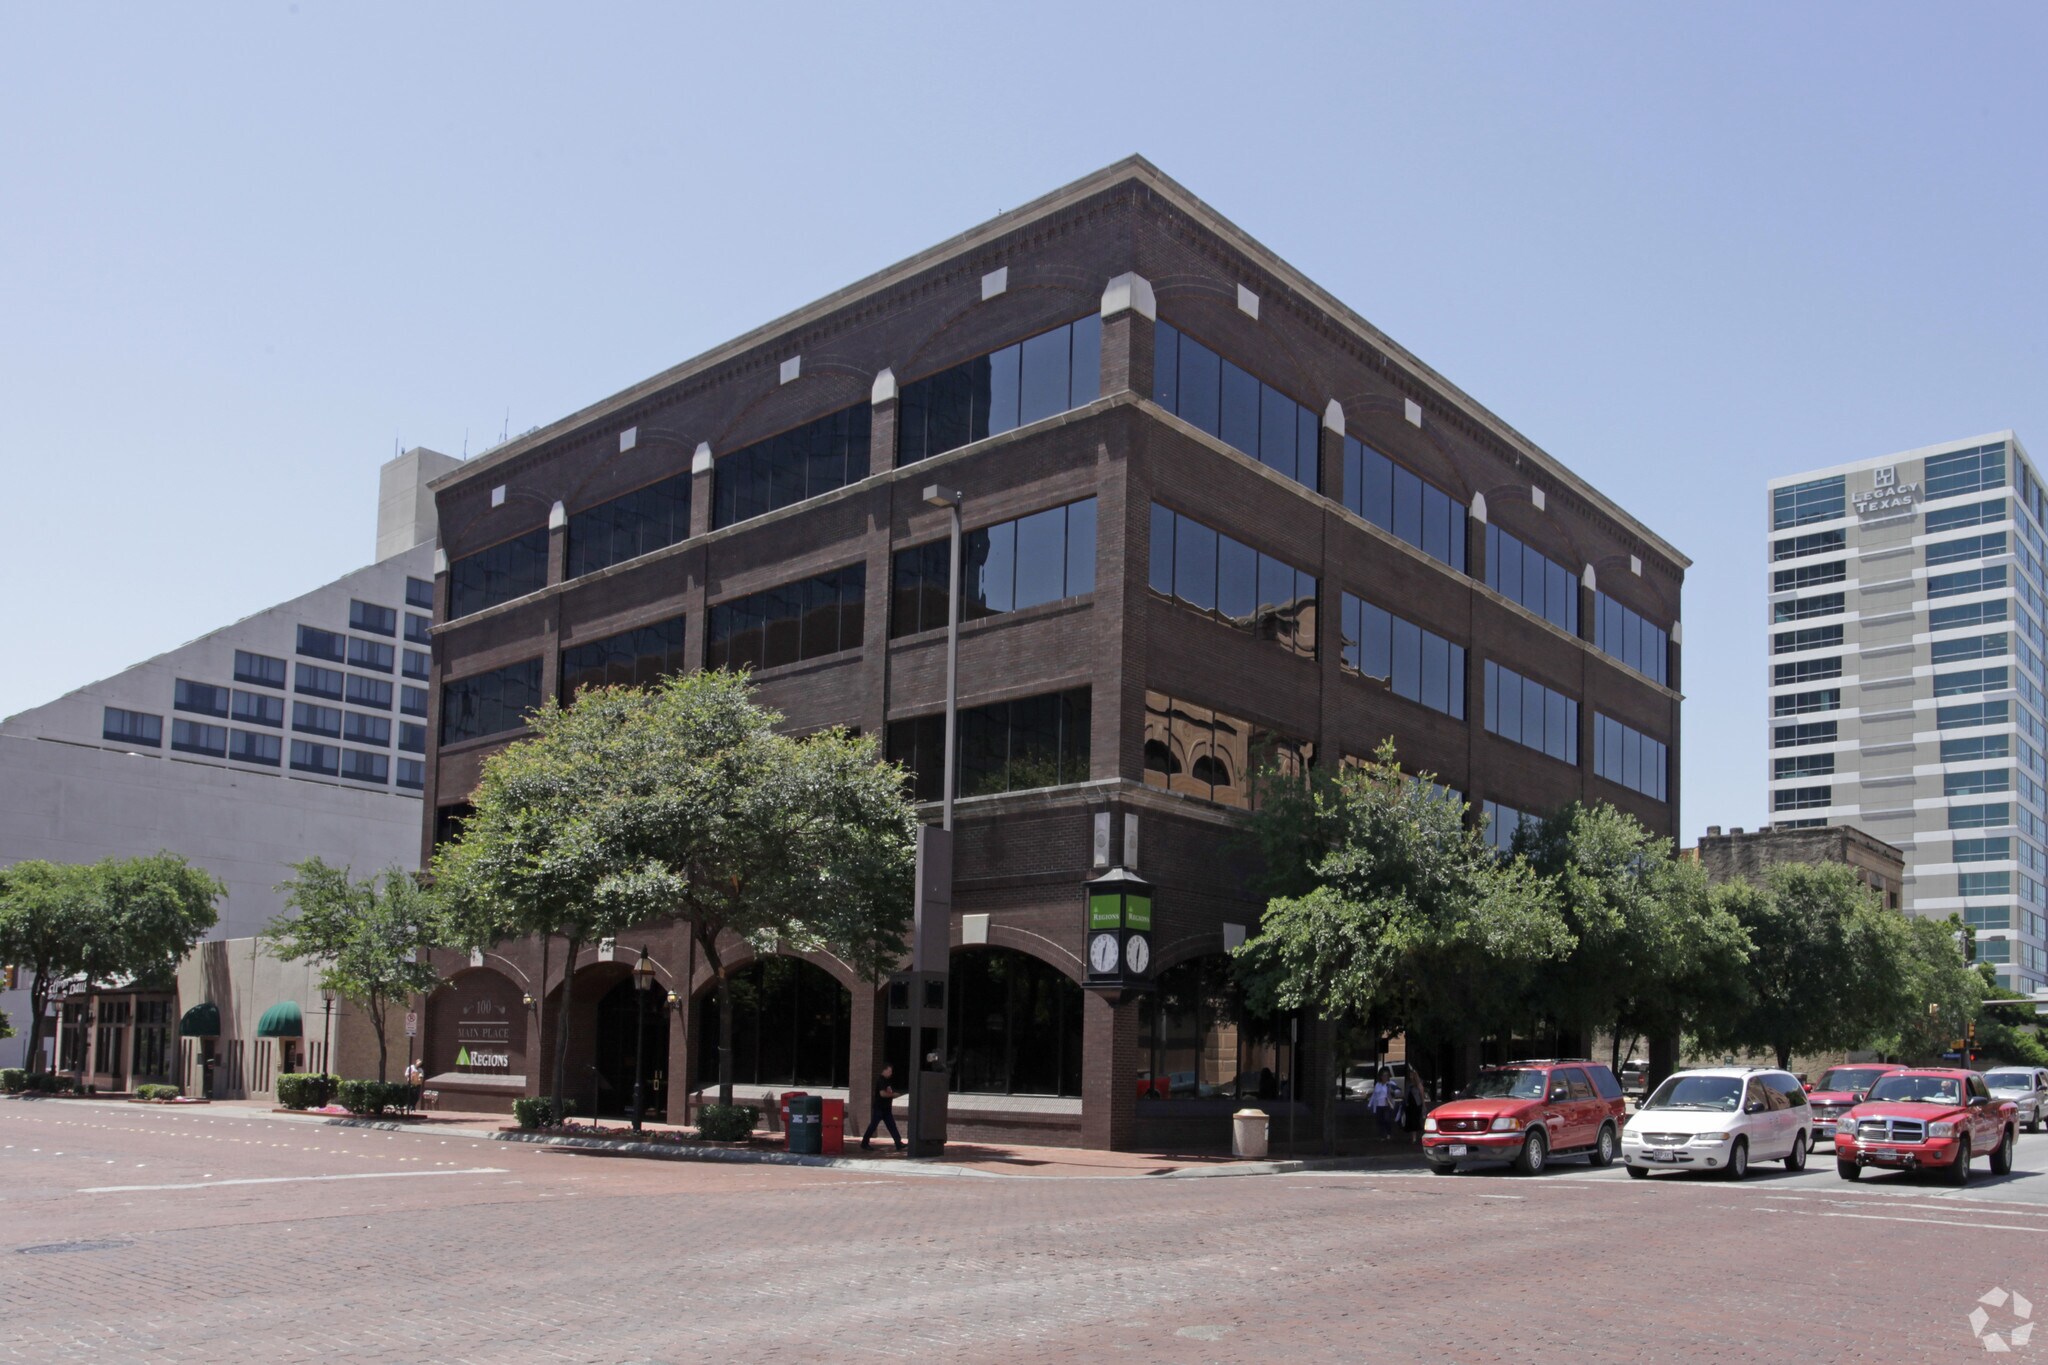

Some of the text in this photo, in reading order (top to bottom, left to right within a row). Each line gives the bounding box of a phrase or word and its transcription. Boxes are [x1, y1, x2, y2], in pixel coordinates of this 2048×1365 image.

[1851, 482, 1918, 503] LEGACY
[1857, 496, 1912, 513] TEXAS
[1093, 913, 1120, 921] REGIONS
[477, 1000, 492, 1014] 100
[458, 1028, 509, 1038] MAIN PLACE
[470, 1051, 508, 1067] REGIONS
